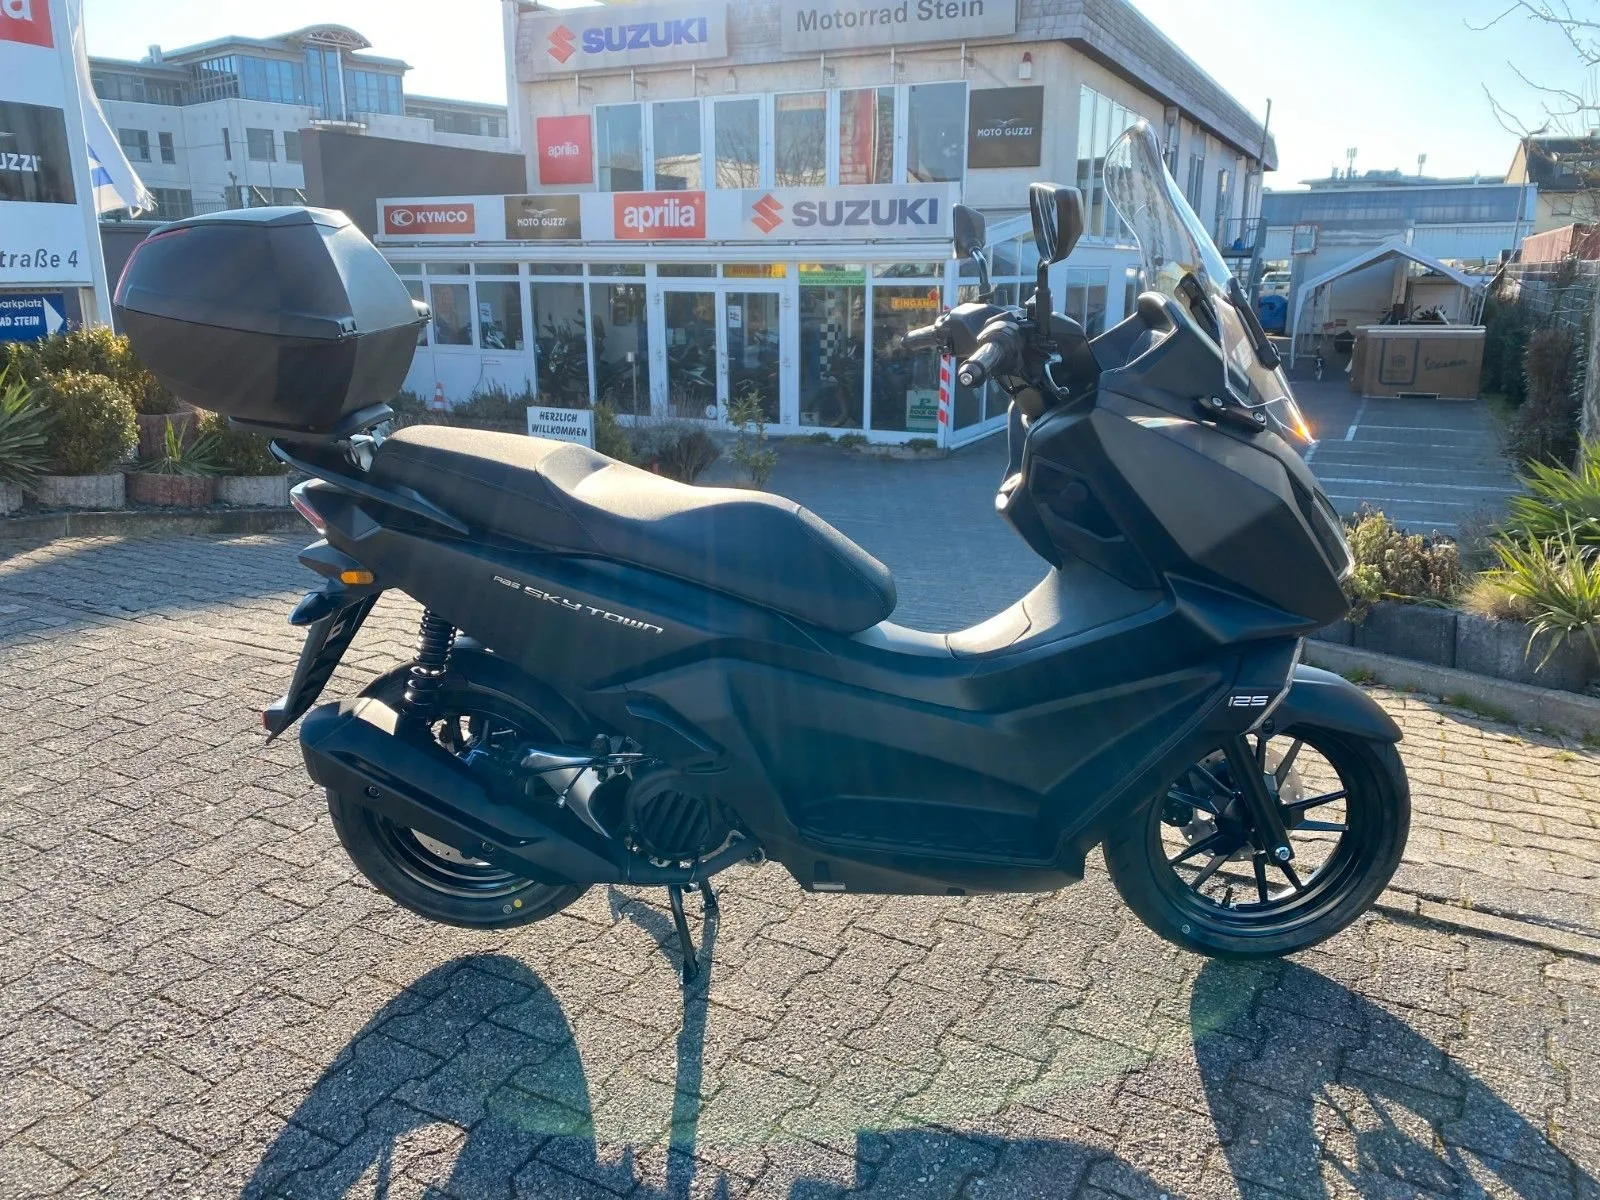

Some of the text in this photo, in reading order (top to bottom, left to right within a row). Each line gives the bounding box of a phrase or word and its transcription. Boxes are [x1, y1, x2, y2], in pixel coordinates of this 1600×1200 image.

[797, 0, 984, 31] Motorrad Stein
[582, 17, 708, 53] SUZUKI
[977, 127, 1032, 136] MOTO GUZZI
[548, 142, 579, 158] aprilia
[416, 211, 468, 223] KYMCO
[623, 198, 696, 233] aprilia
[792, 198, 939, 227] SUZUKI
[517, 217, 567, 227] MOTO GUZZI
[67, 249, 79, 268] 4
[0, 299, 42, 309] arkplatz
[894, 299, 937, 307] EINGANG
[14, 315, 40, 327] STEIN
[539, 411, 578, 423] HERZLICH
[531, 423, 588, 437] WILLKOMMEN
[1228, 695, 1269, 707] 125
